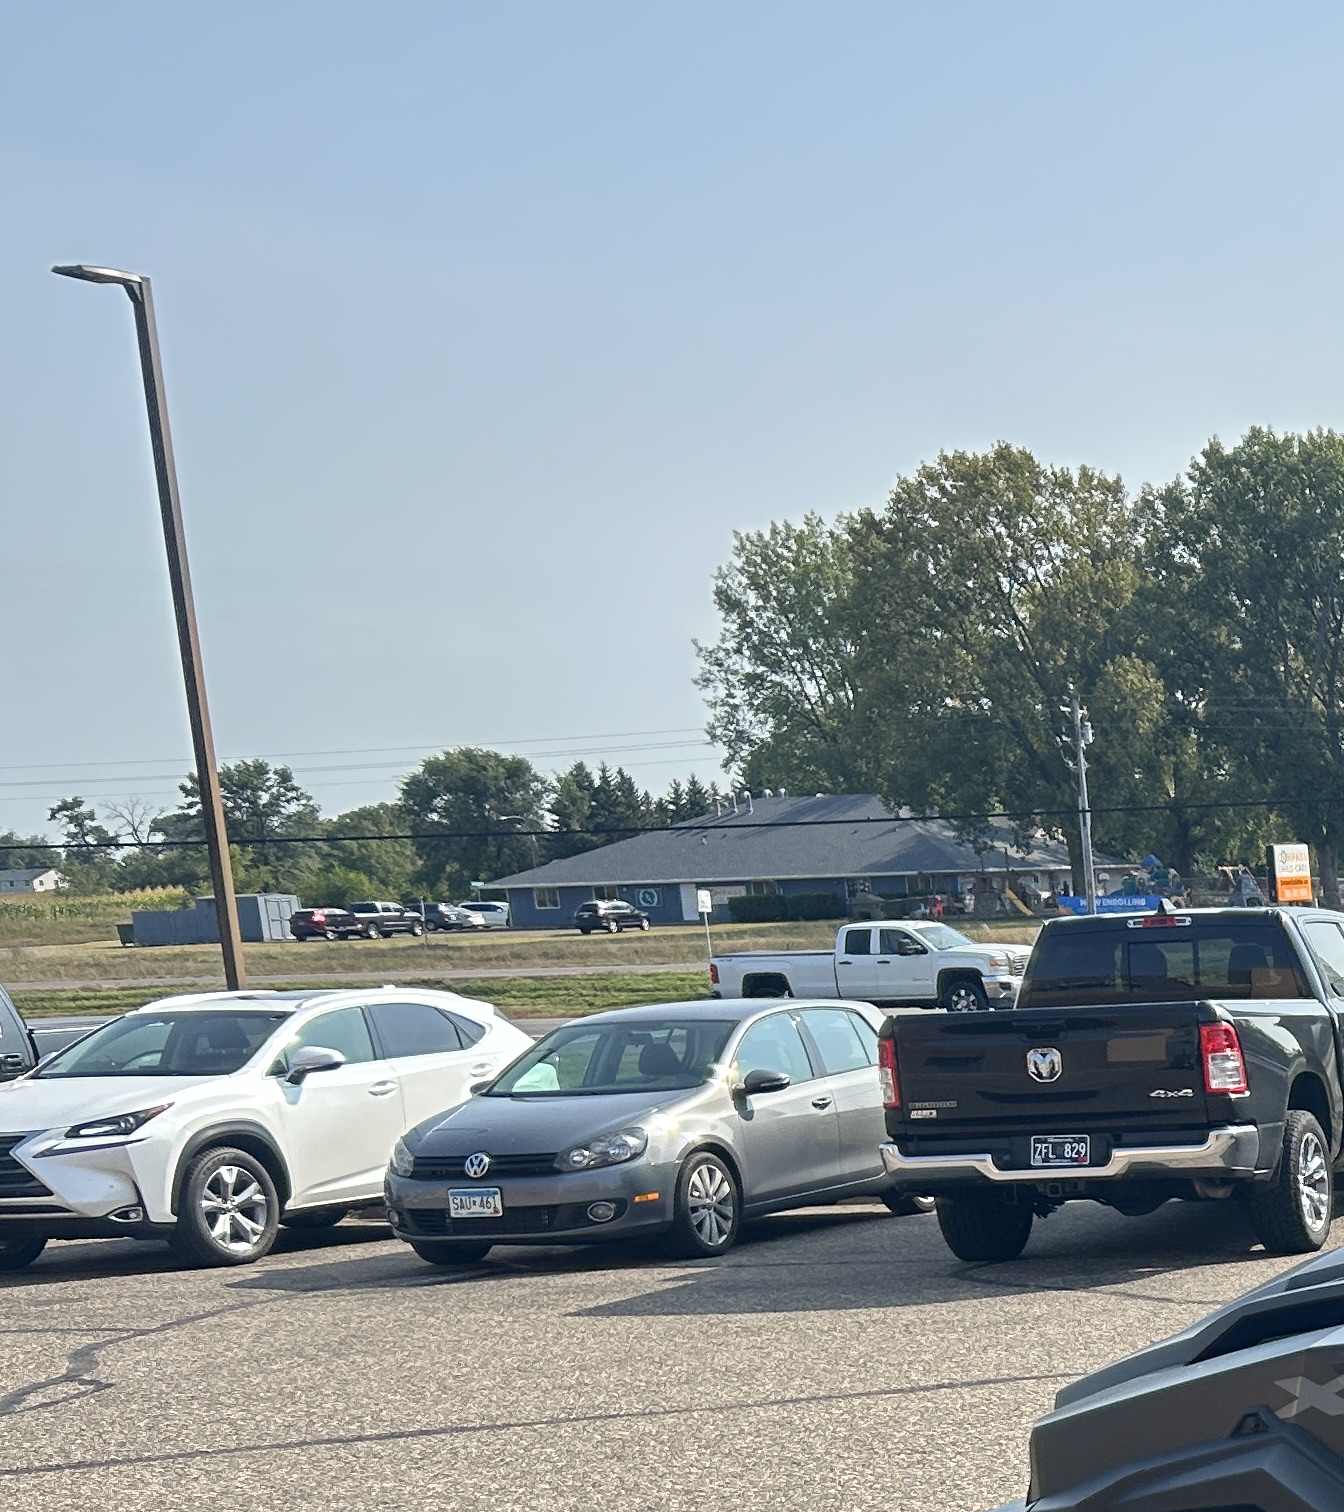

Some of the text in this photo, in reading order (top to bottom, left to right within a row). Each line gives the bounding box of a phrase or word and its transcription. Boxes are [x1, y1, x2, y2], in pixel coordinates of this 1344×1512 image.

[1150, 1088, 1194, 1098] 4x4
[1034, 1142, 1086, 1159] ZFL 829
